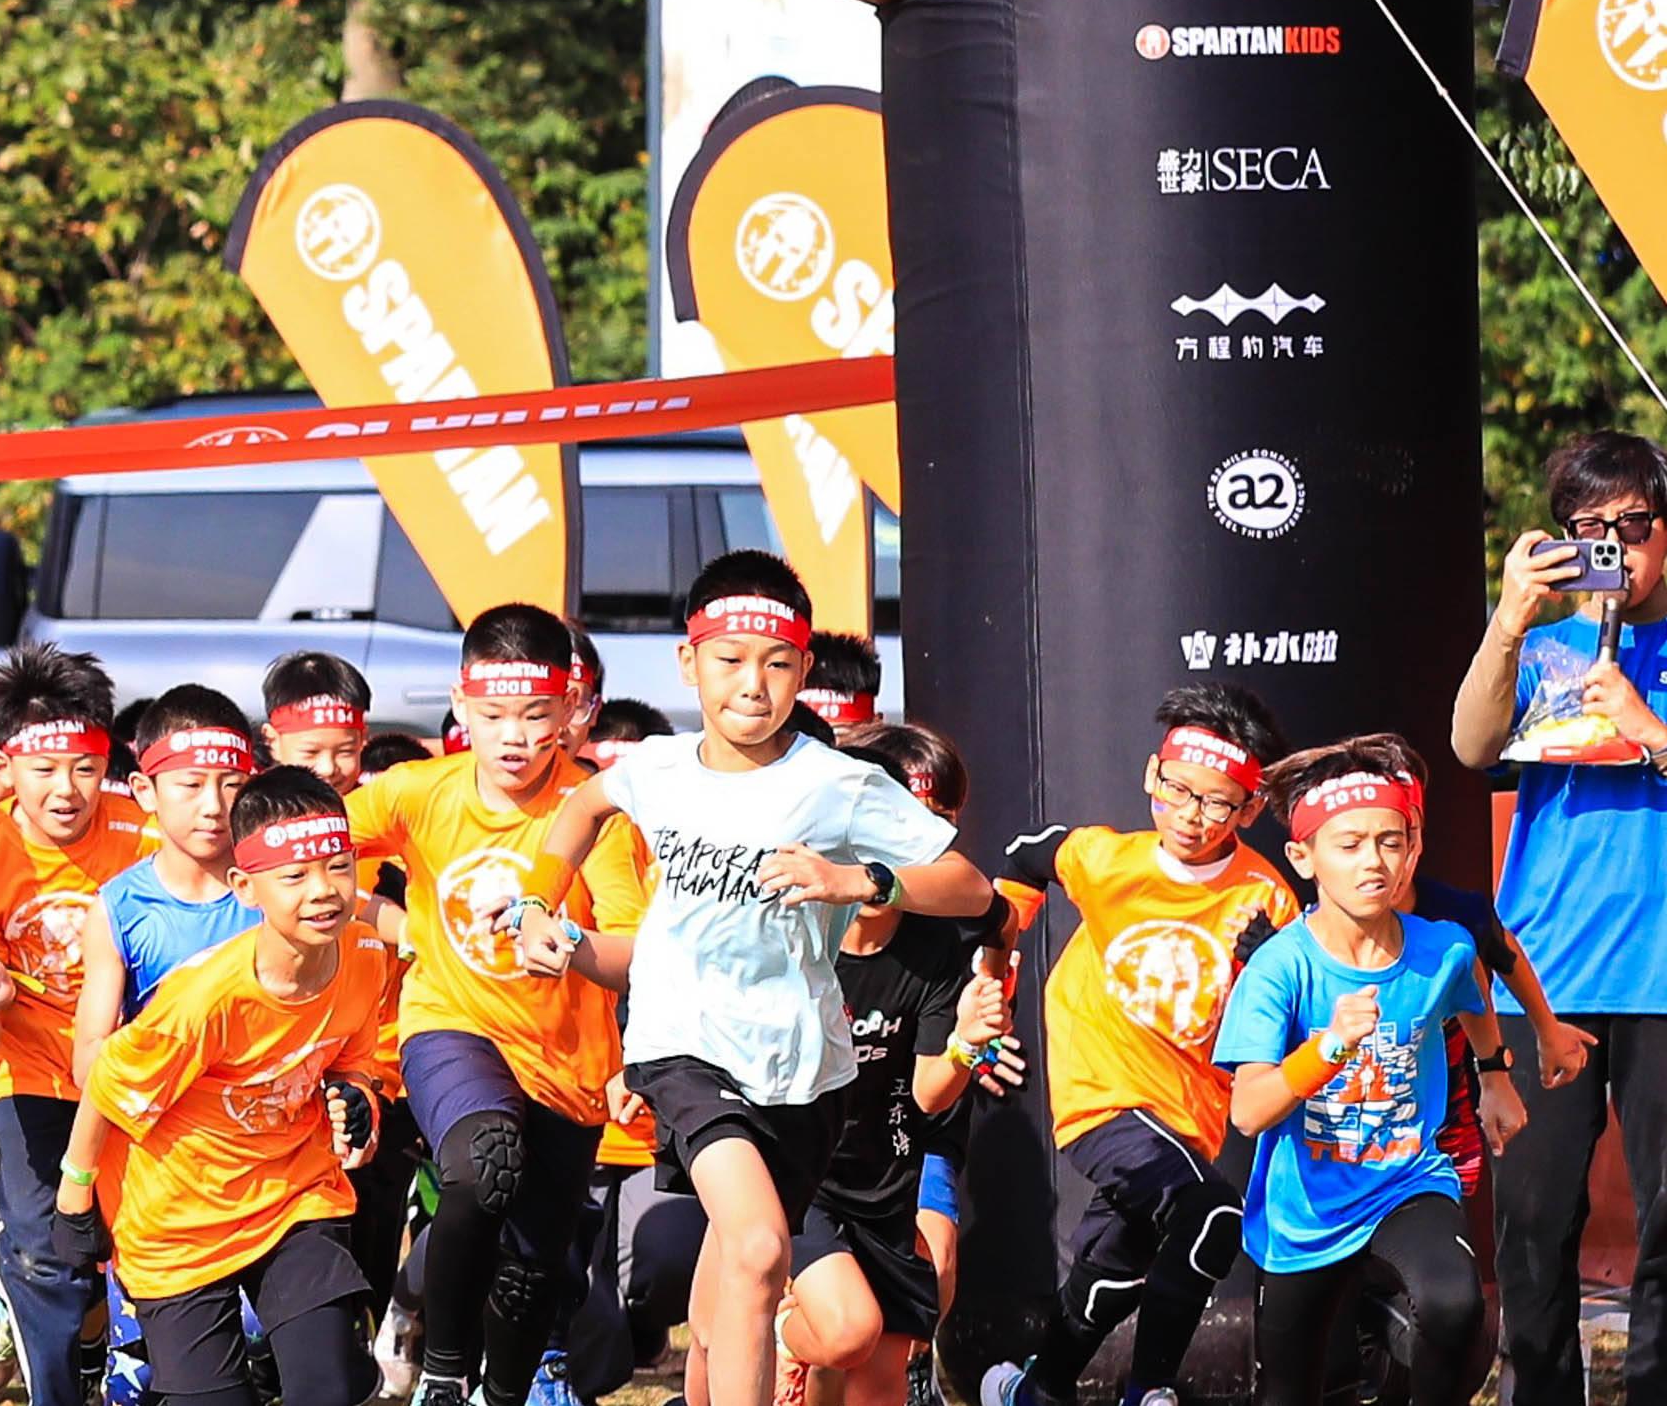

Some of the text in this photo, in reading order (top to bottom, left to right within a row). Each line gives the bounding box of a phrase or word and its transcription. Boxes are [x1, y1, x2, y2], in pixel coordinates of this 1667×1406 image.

[1170, 26, 1341, 57] SPARTANKIDS
[1211, 146, 1332, 192] SECA
[1222, 450, 1249, 470] MILK
[1252, 448, 1301, 480] COMPANY
[1227, 472, 1289, 511] a2
[723, 596, 796, 623] SPARTAN
[726, 614, 779, 633] 2101
[1222, 629, 1339, 666] 补水啦
[193, 749, 238, 766] 2041
[1179, 746, 1229, 773] 2004
[292, 837, 342, 860] 2143
[653, 825, 778, 875] TEMPORA
